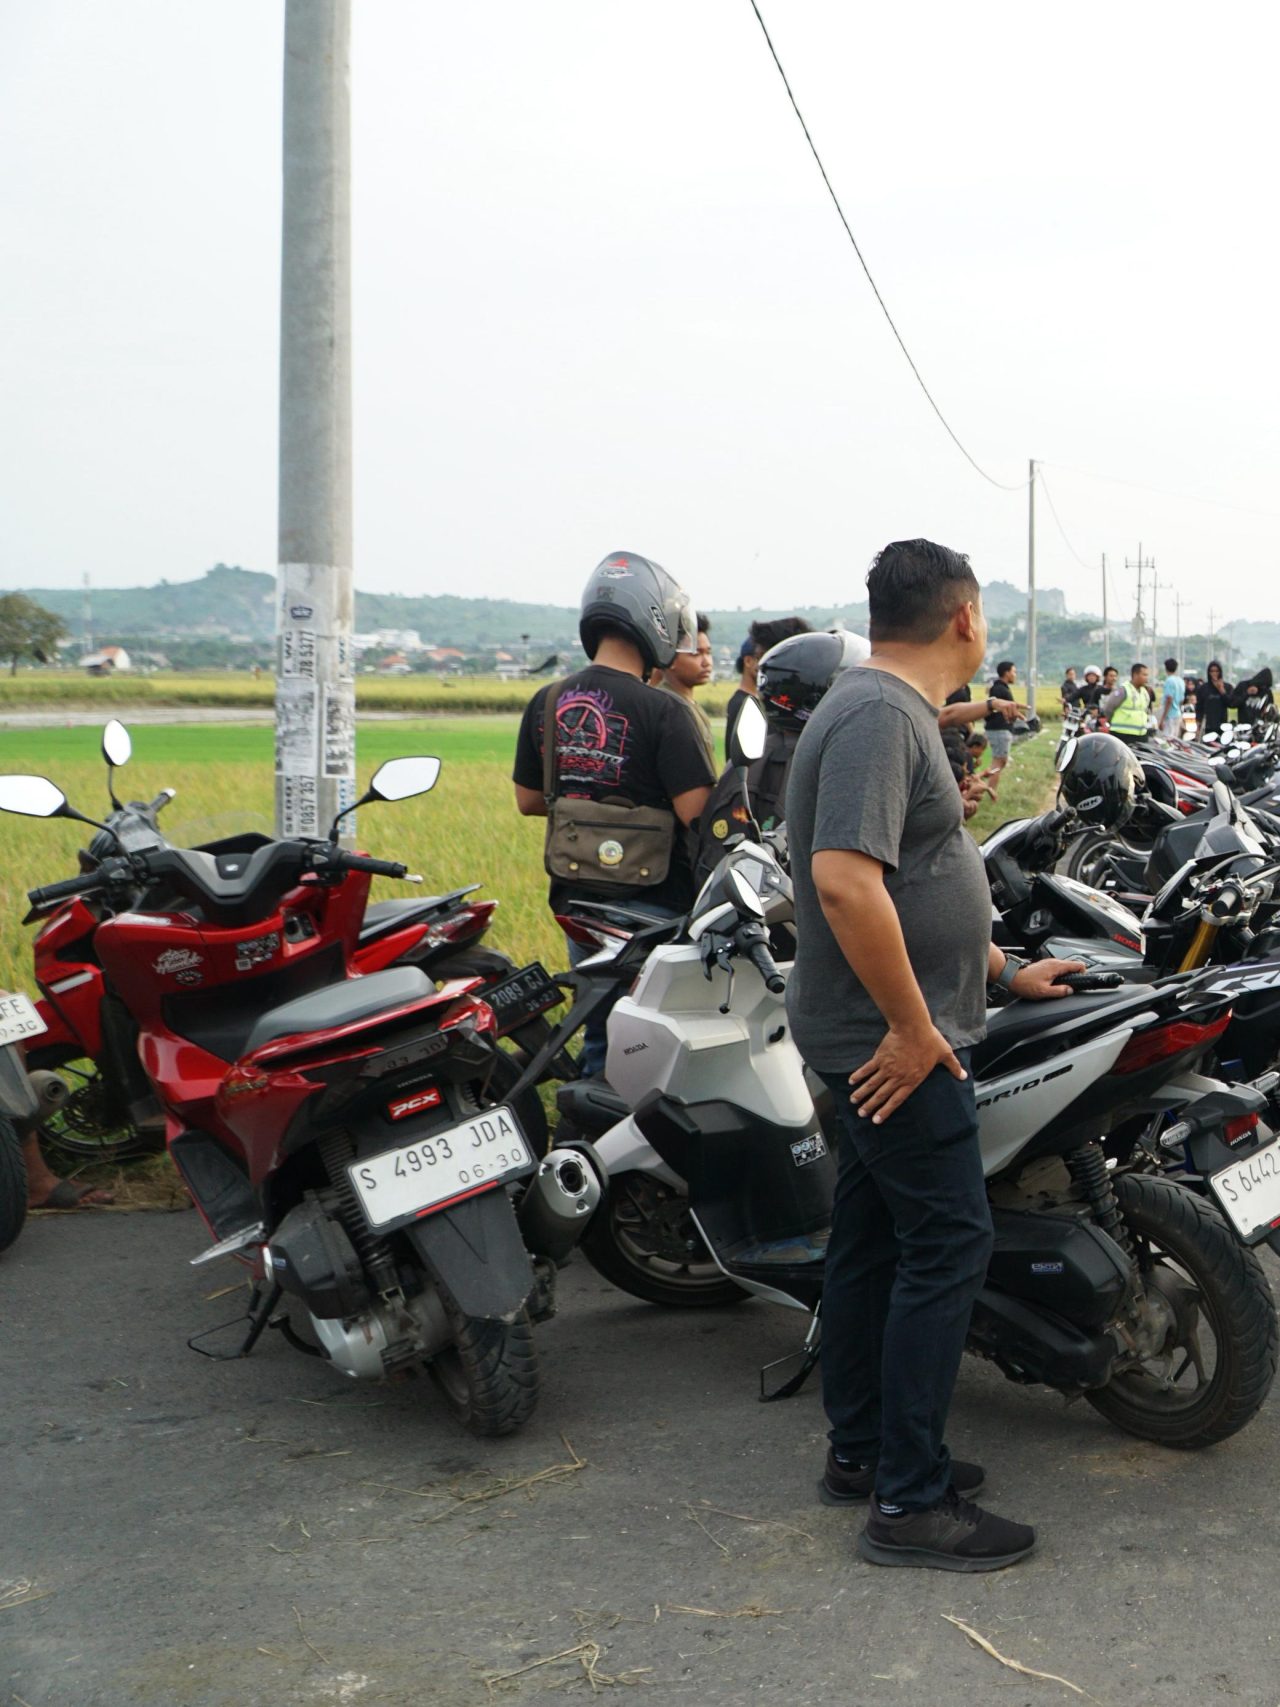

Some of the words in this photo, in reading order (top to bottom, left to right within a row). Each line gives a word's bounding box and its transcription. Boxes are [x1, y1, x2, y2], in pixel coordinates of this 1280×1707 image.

[490, 982, 525, 1007] 2089
[392, 1092, 439, 1117] PCX
[975, 1078, 1041, 1111] ARIO
[360, 1168, 377, 1190] S
[394, 1137, 454, 1178] 4993
[469, 1115, 513, 1148] JDA
[1230, 1131, 1252, 1146] HONDA
[1221, 1178, 1238, 1202] S
[1238, 1152, 1280, 1192] 6442
